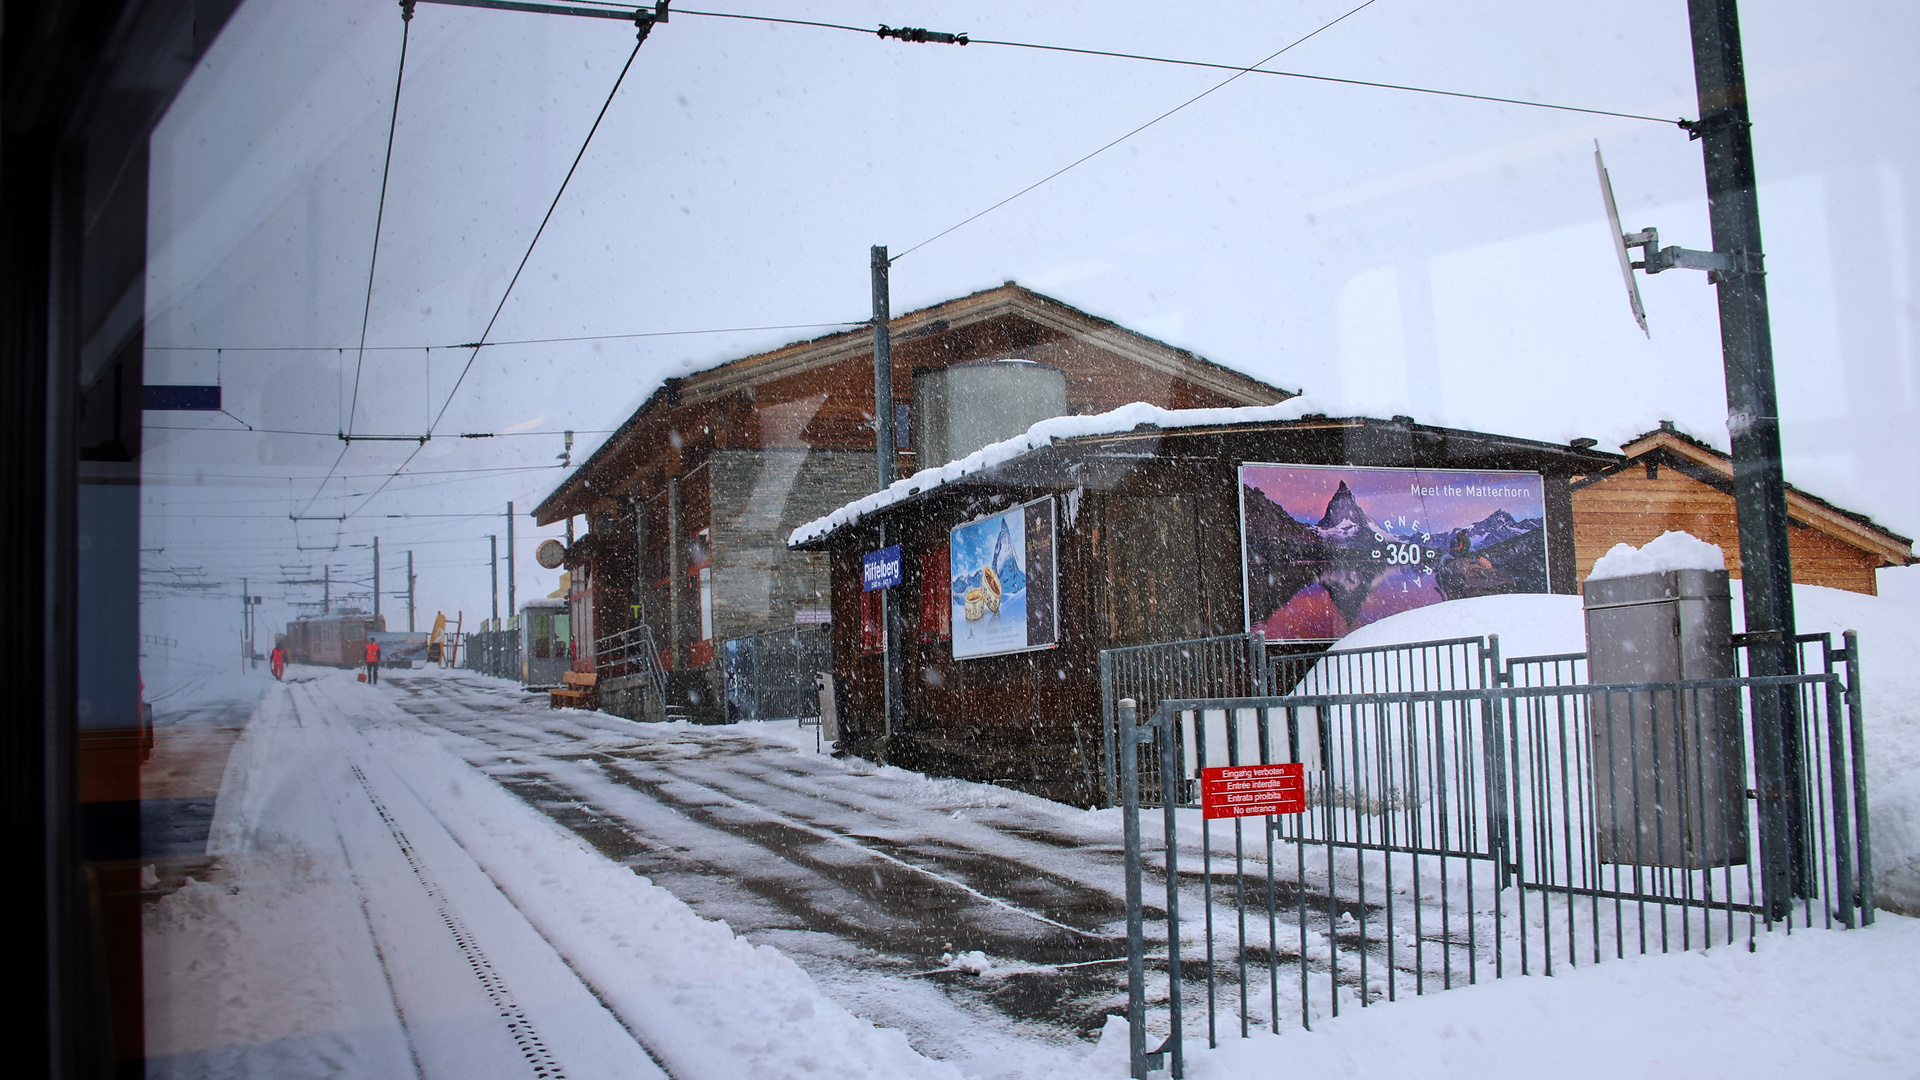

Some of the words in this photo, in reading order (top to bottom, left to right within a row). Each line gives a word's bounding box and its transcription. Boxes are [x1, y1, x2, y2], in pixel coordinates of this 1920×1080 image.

[1411, 484, 1439, 496] Meet
[1444, 485, 1462, 497] the
[1466, 485, 1530, 498] Matterhorn
[1371, 515, 1436, 593] GORNERGRAT
[1386, 543, 1421, 565] 360
[864, 559, 899, 582] Riffelberg
[1222, 769, 1252, 778] Eingang
[1254, 768, 1284, 776] verboten
[1227, 781, 1250, 790] Entrée
[1251, 780, 1281, 788] interdite
[1227, 794, 1253, 802] Entrata
[1254, 791, 1281, 802] proibita
[1233, 806, 1244, 814] No
[1245, 805, 1276, 813] entrance
